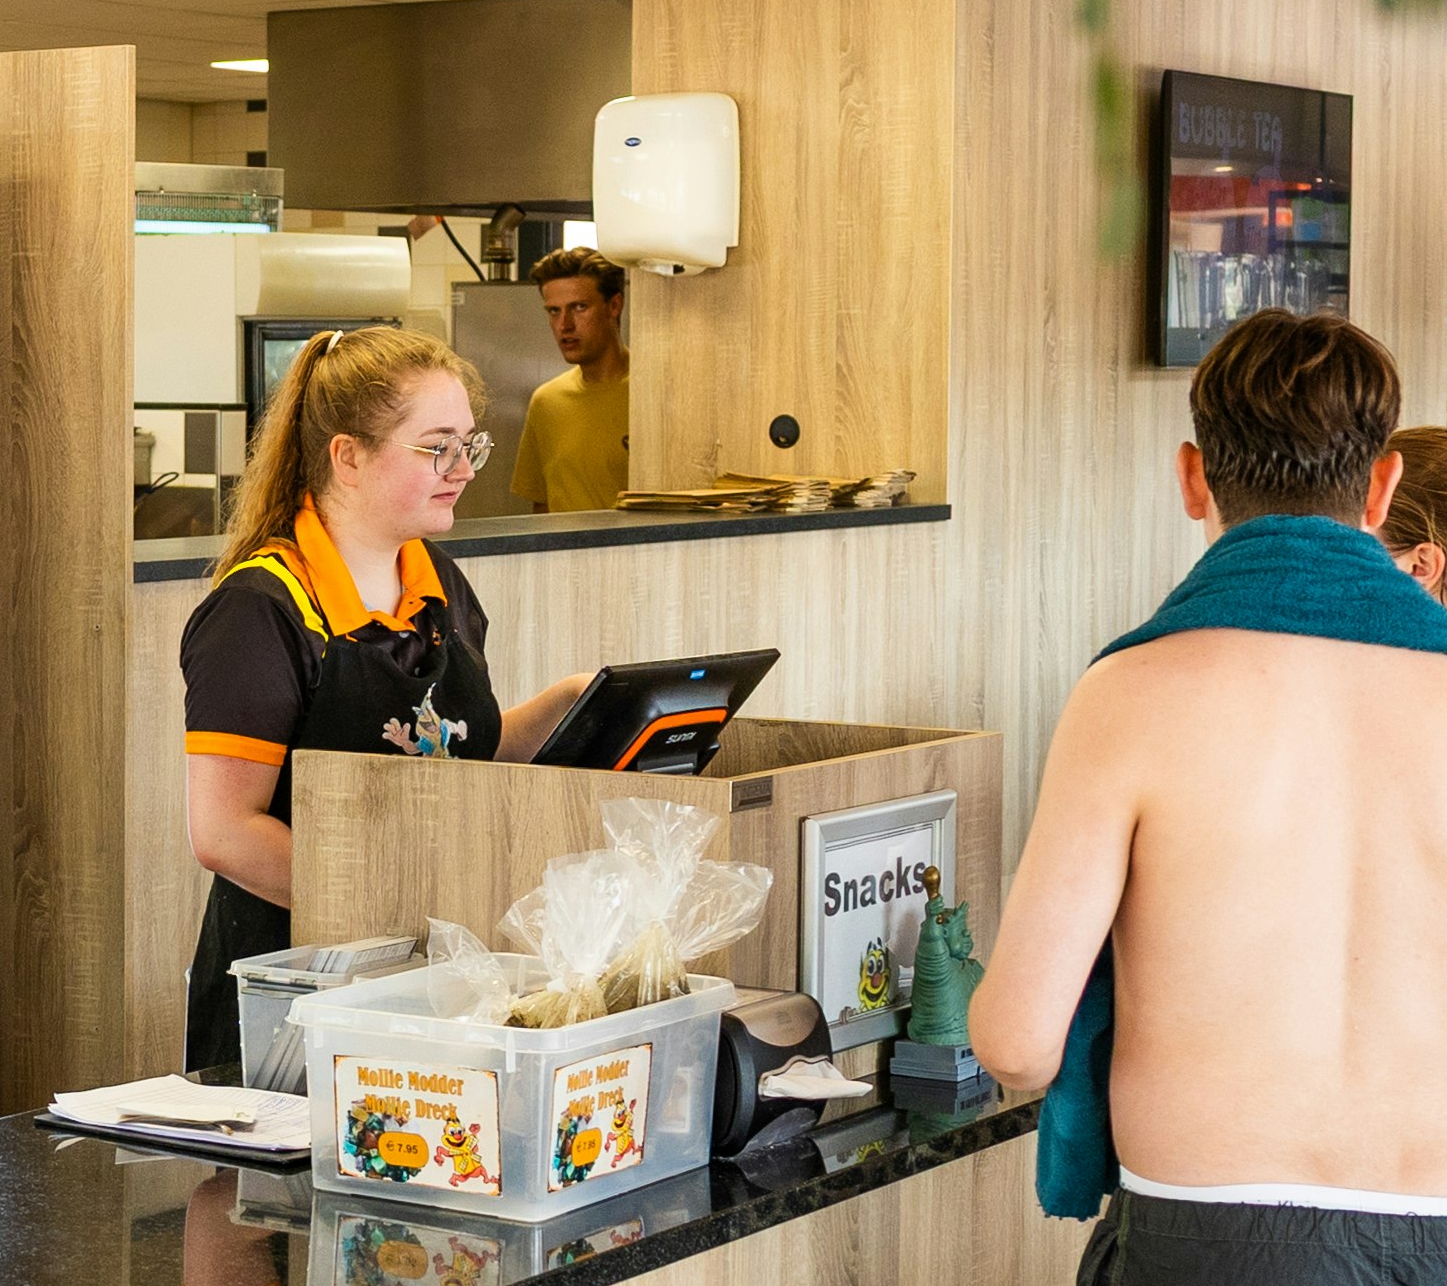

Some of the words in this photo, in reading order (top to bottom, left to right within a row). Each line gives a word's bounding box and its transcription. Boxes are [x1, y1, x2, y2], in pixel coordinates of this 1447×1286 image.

[1178, 101, 1247, 150] BUBBLE
[1253, 112, 1283, 153] TEA
[824, 856, 926, 917] Snacks
[357, 1065, 404, 1090] Mollie
[407, 1070, 465, 1097] Modder
[566, 1068, 594, 1094] Mollie
[596, 1059, 631, 1085] Modder
[365, 1093, 411, 1120] Mollie
[415, 1098, 458, 1121] Dreck
[386, 1140, 395, 1152] €
[397, 1143, 419, 1155] 7.95
